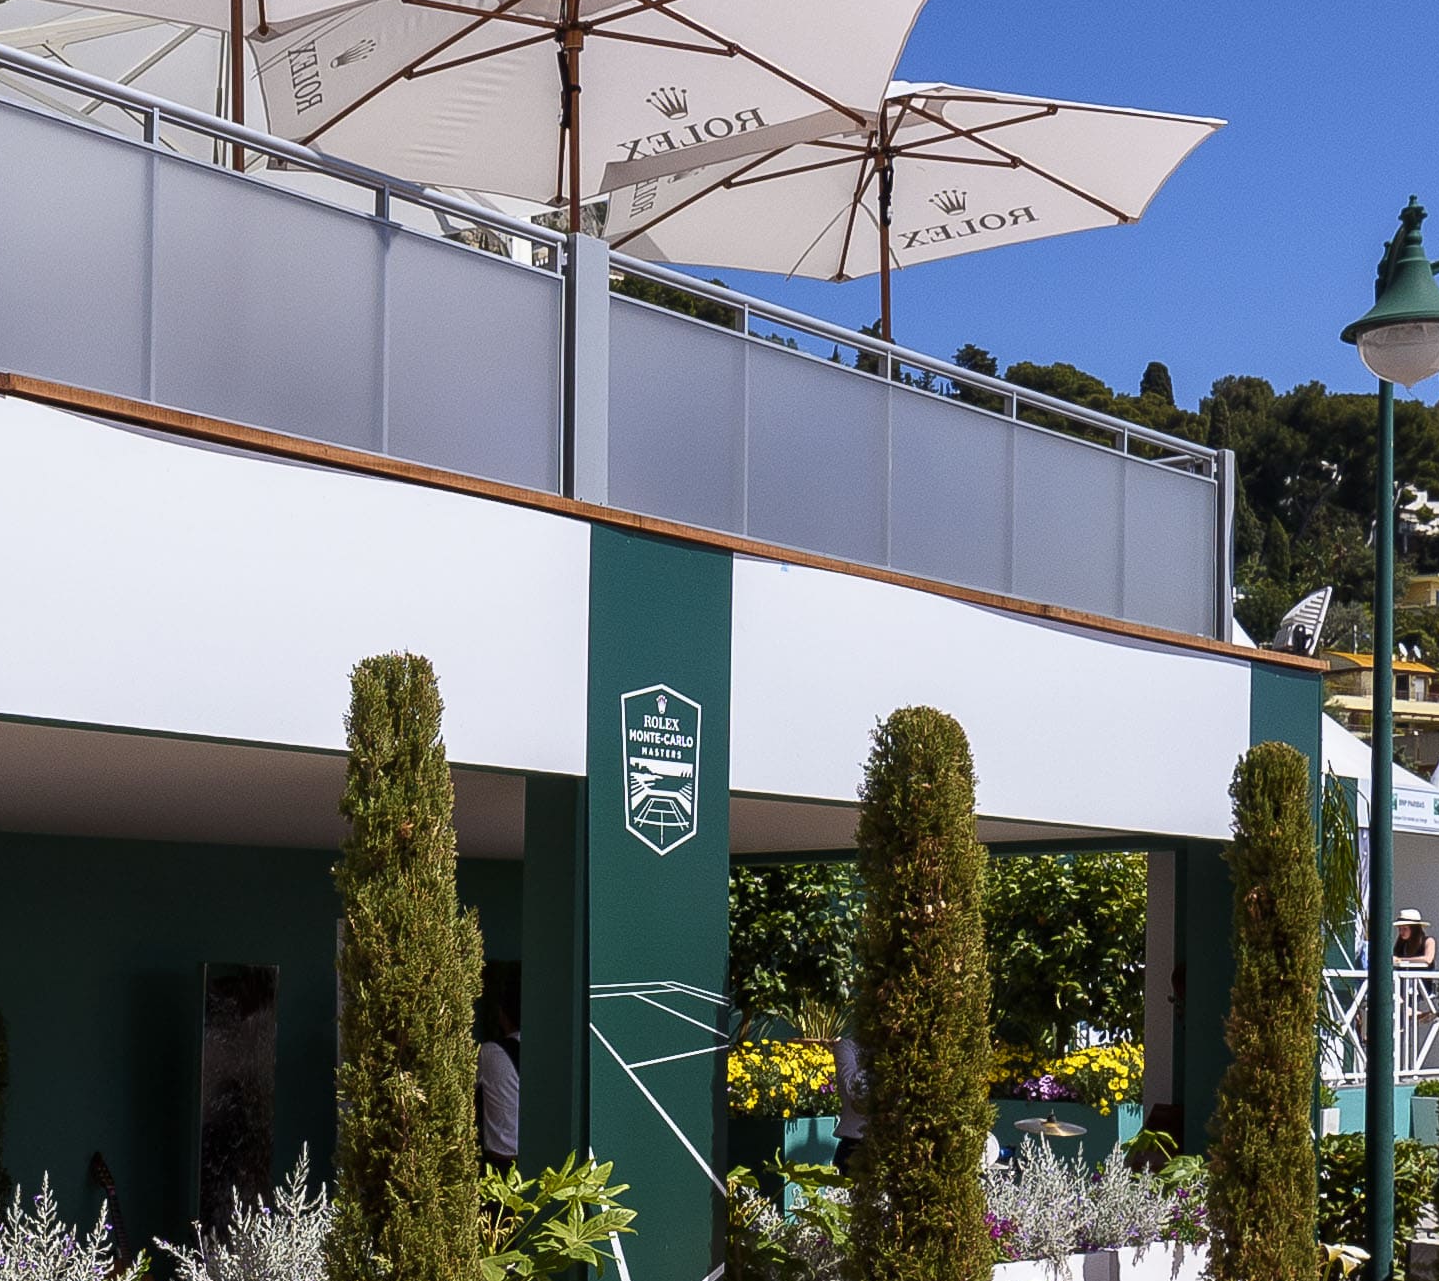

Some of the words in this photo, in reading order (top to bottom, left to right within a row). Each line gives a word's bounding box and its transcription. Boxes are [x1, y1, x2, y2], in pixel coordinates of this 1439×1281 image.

[643, 714, 680, 731] ROLEX
[629, 728, 694, 748] MONTE-CARLO
[641, 746, 682, 759] MASTERS
